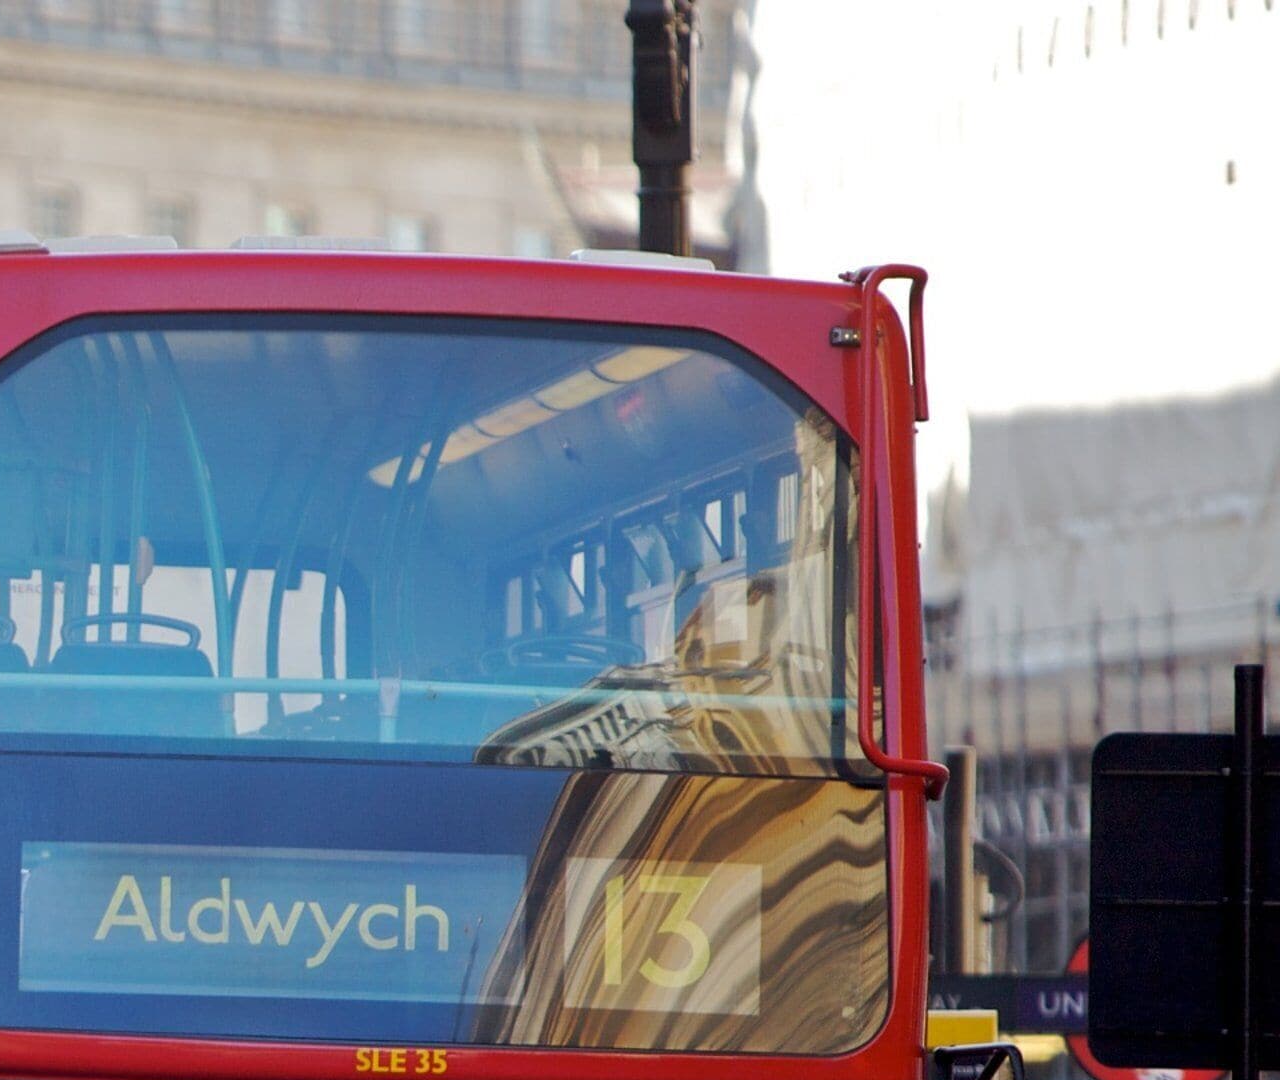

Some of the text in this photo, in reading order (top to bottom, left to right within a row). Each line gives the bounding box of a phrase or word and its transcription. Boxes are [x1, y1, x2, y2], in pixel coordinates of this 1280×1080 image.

[94, 875, 449, 967] Aldwych
[604, 874, 711, 988] 13
[1039, 990, 1085, 1018] UN
[356, 1047, 448, 1074] SLE 35
